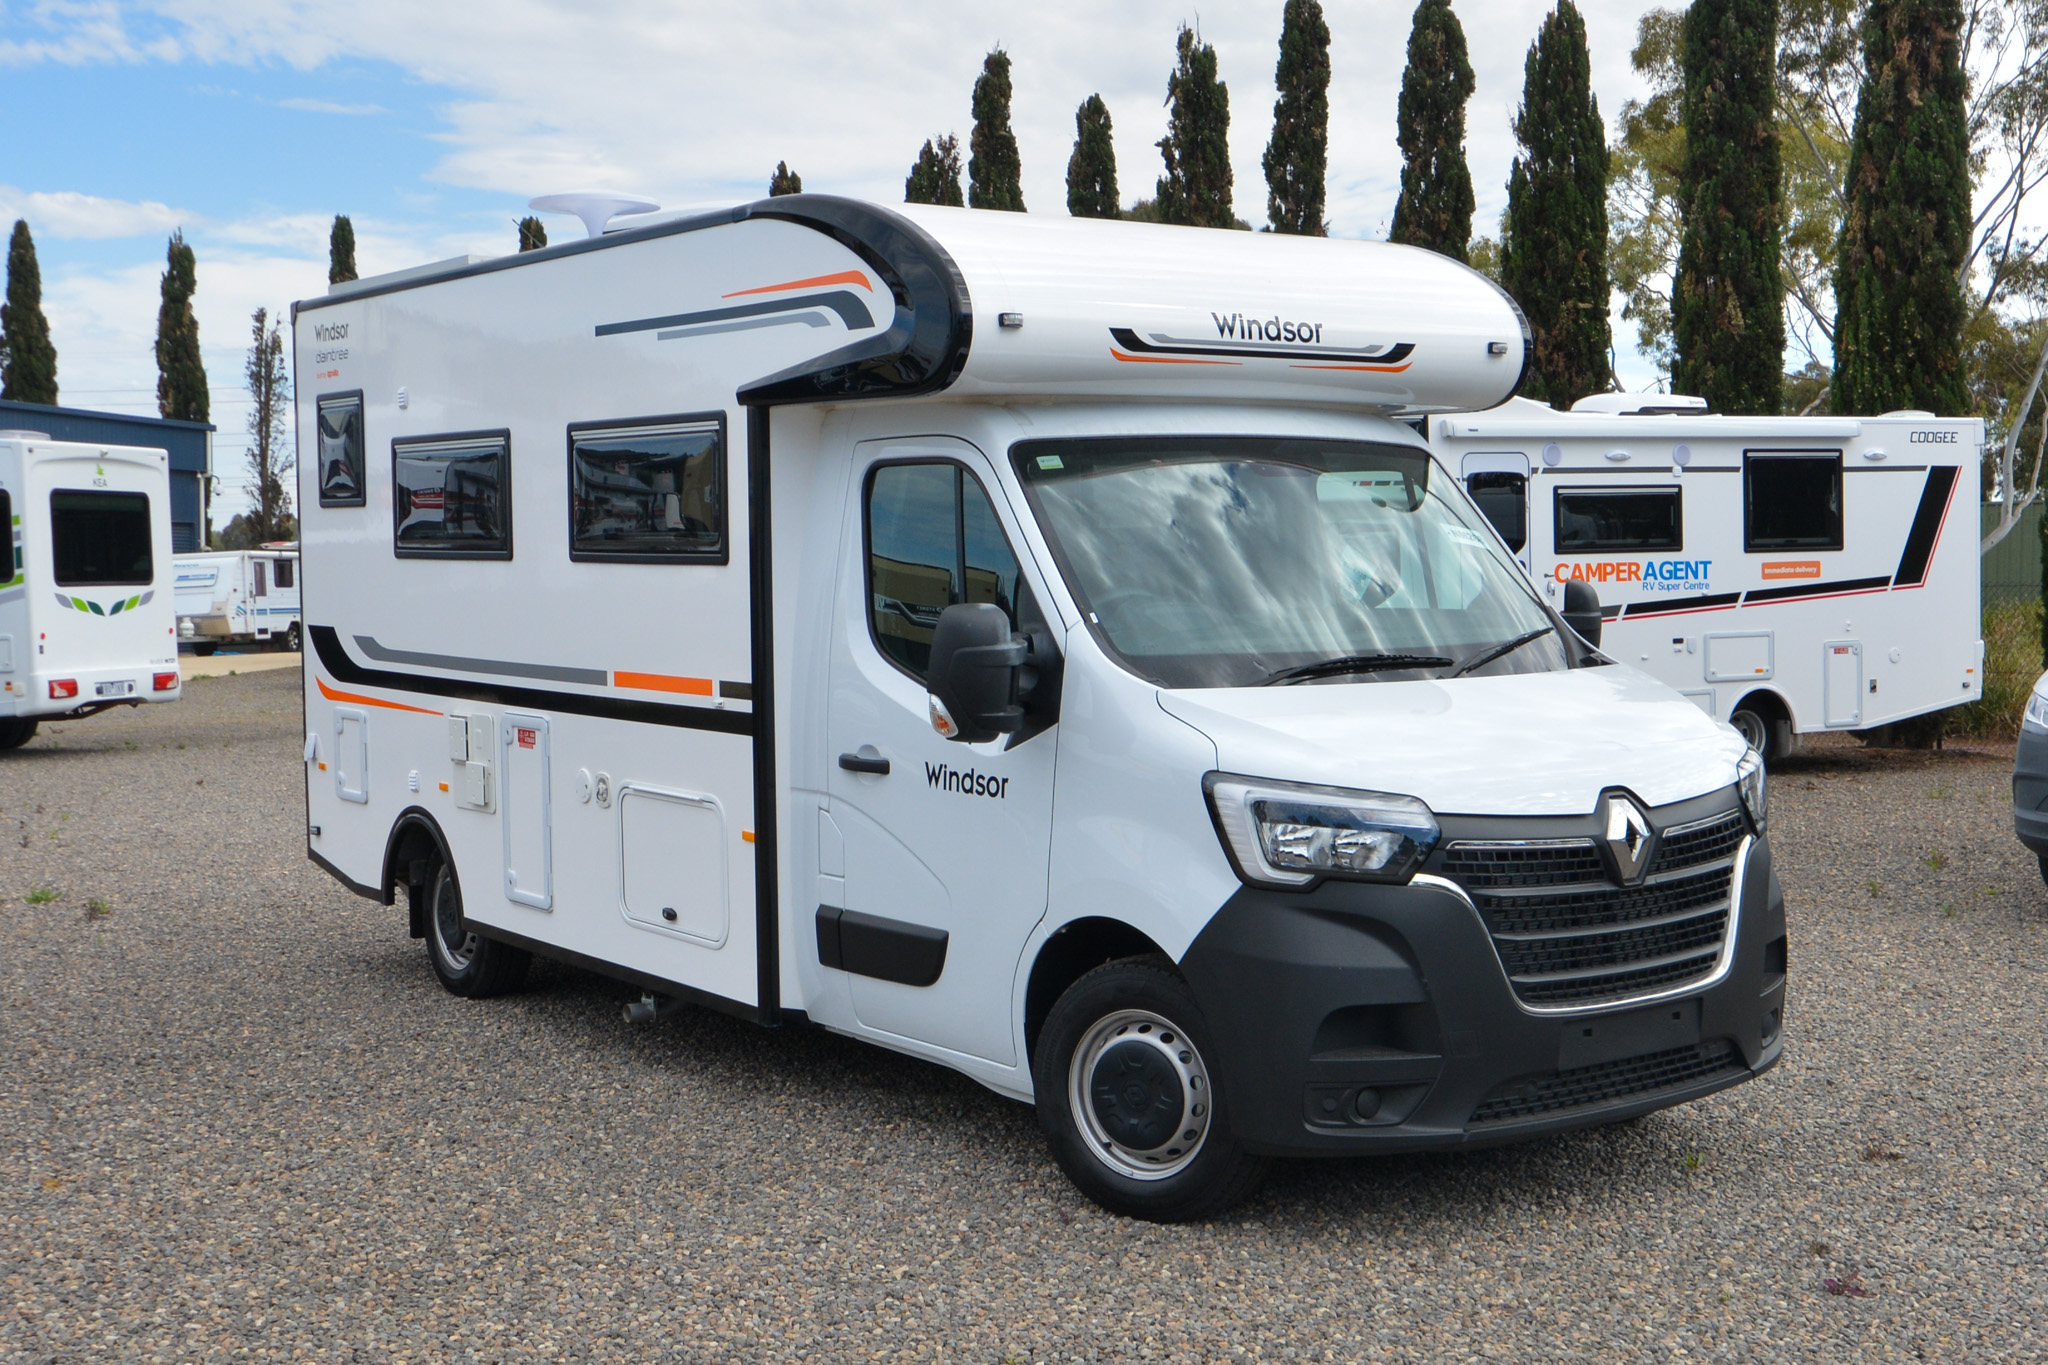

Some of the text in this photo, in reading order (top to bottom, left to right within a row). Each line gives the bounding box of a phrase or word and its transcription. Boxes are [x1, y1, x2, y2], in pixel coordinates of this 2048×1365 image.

[314, 323, 349, 342] Windsor
[1210, 311, 1323, 344] Windsor
[1910, 431, 1959, 443] COOGEE
[93, 479, 108, 488] KEA
[1642, 581, 1710, 592] RV Super Centre
[925, 761, 1009, 799] Windsor
